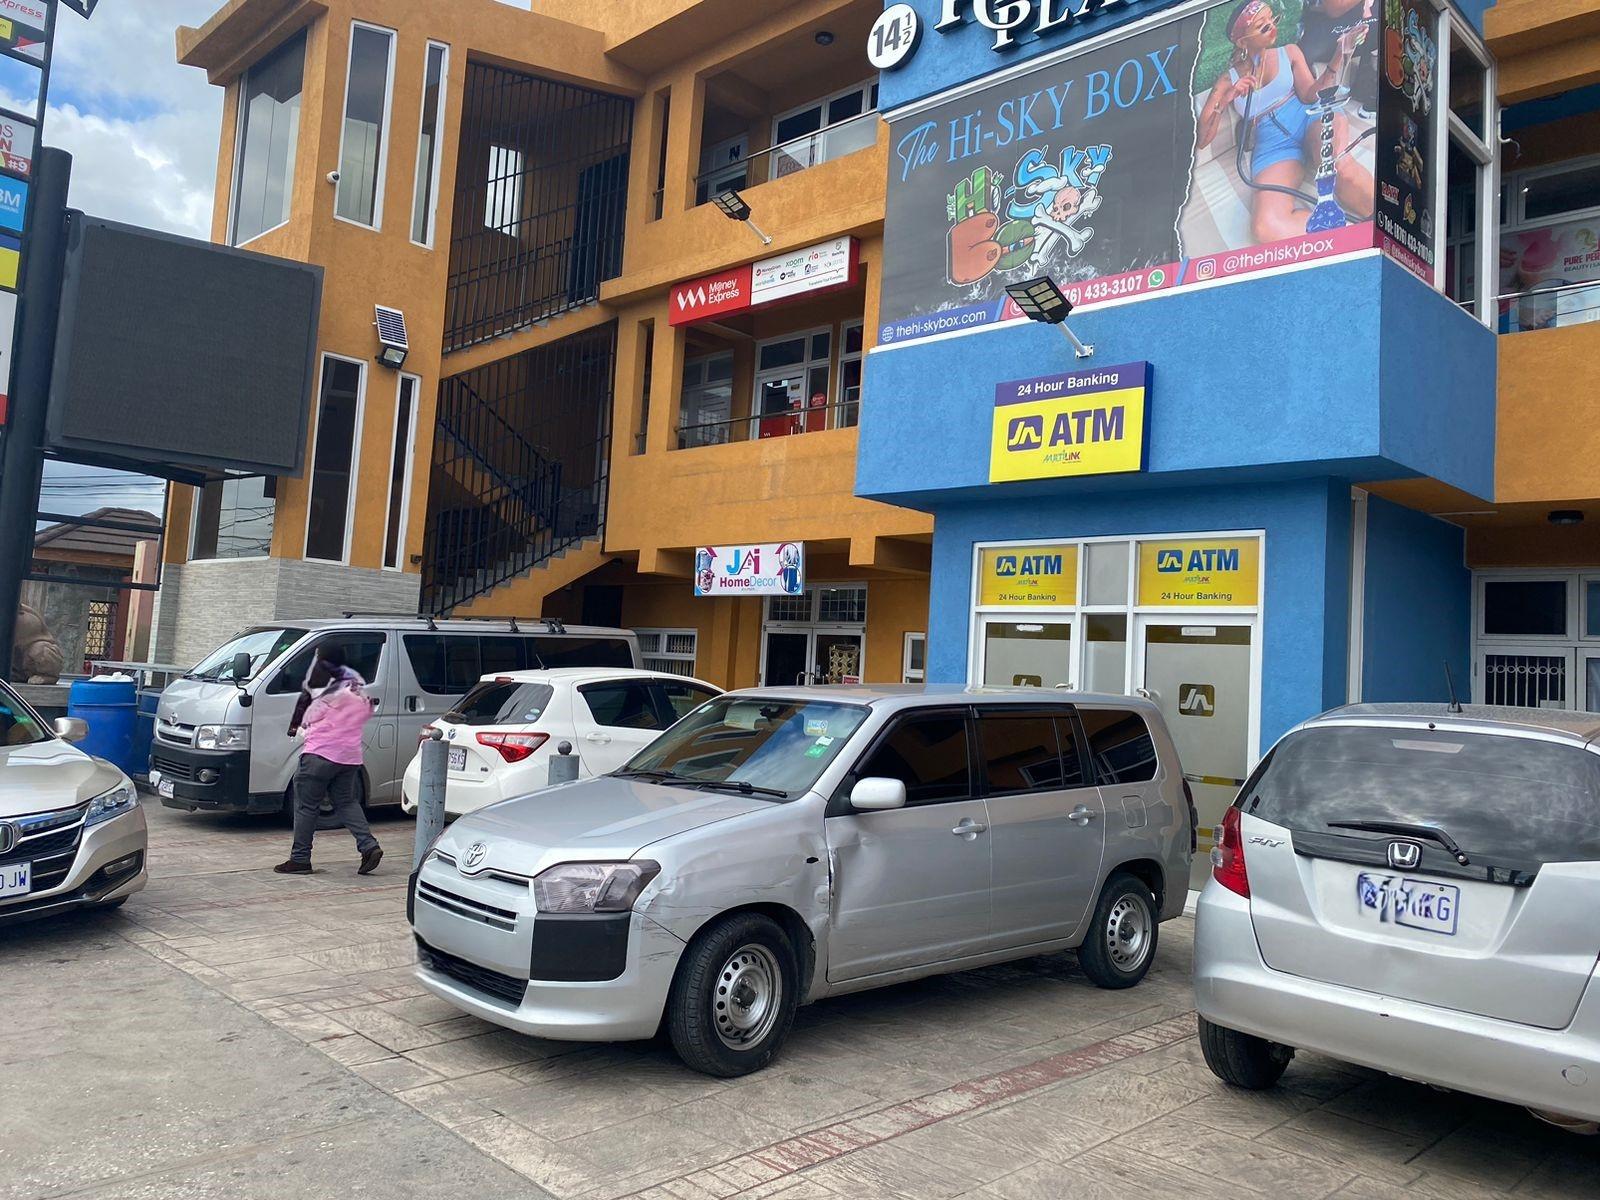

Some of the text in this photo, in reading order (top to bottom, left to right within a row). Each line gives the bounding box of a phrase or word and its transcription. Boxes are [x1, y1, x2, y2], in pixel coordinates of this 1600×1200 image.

[897, 120, 941, 182] The
[1083, 45, 1179, 120] BOX
[785, 257, 804, 268] xoom
[1223, 238, 1335, 273] @thehiskybox
[709, 288, 740, 304] Express
[1084, 275, 1143, 300] 433-3107
[896, 310, 987, 337] thehi-skybox.com
[1017, 373, 1119, 396] 24 Hour Banking
[1049, 406, 1125, 447] ATM
[1020, 555, 1062, 575] ATM
[1187, 549, 1239, 571] ATM
[1027, 593, 1056, 602] Banking
[1161, 591, 1232, 602] 24 Hour Banking
